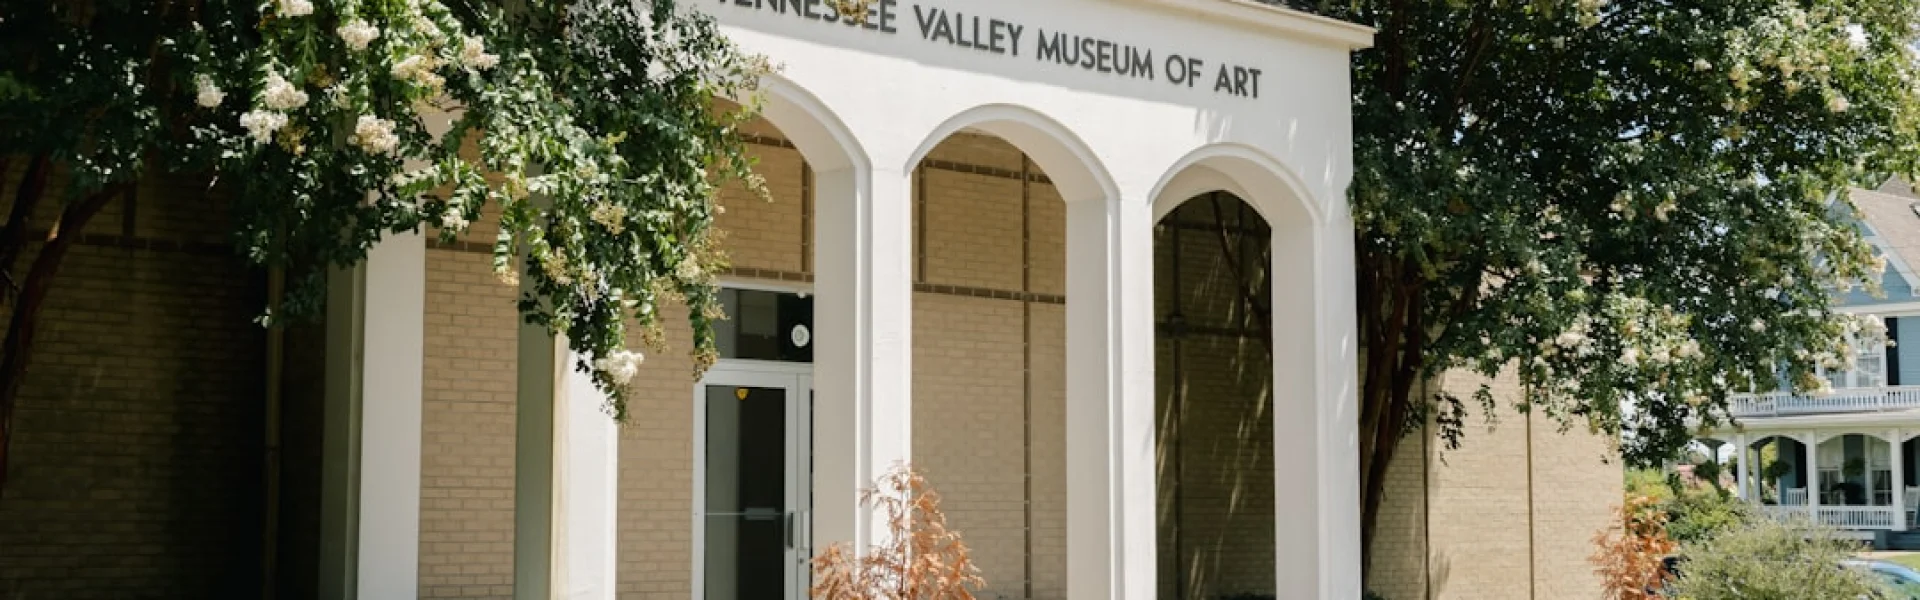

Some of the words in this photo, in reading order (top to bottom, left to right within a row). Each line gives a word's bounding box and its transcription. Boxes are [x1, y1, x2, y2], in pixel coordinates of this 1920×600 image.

[913, 5, 1024, 56] VALLEY
[1037, 29, 1154, 80] MUSEUM
[1166, 55, 1203, 87] OF
[1214, 64, 1262, 99] ART
